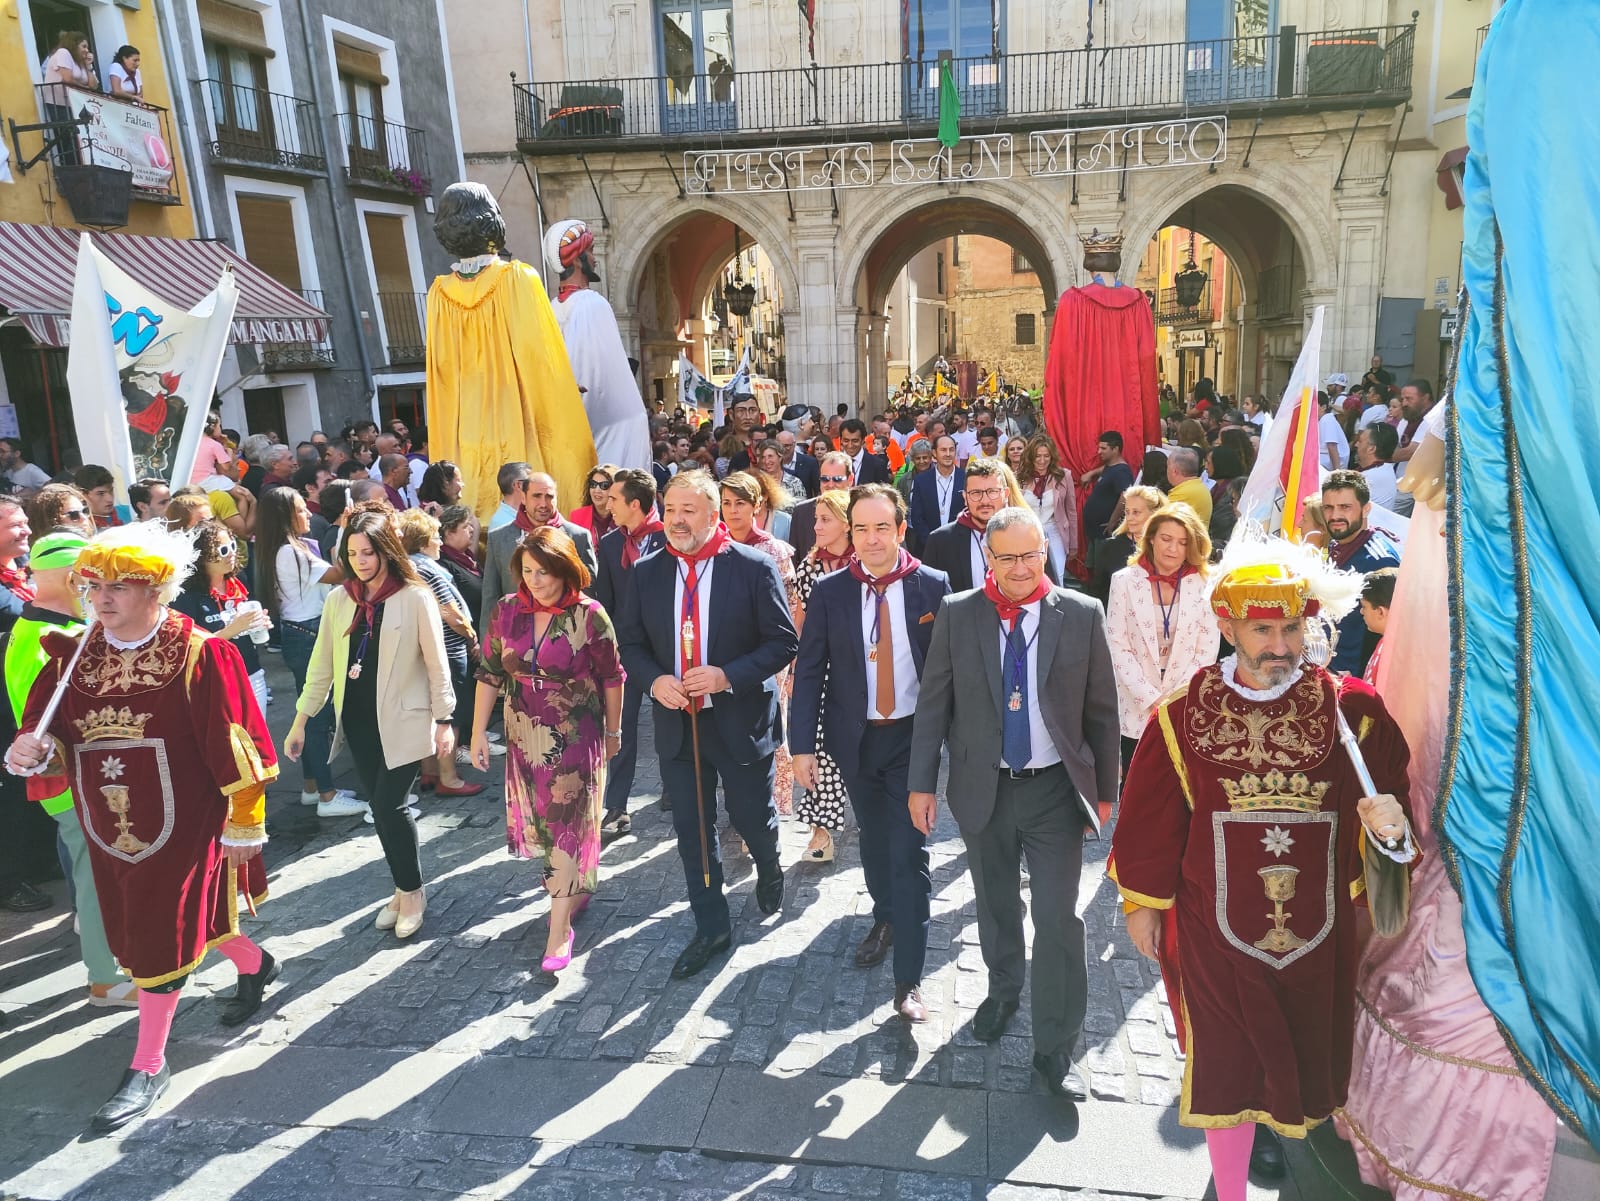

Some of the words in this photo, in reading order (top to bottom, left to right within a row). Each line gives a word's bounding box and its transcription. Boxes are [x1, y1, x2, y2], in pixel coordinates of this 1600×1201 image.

[688, 147, 871, 192] FIESTAS
[894, 137, 1010, 182] SAN
[1032, 121, 1224, 174] MATEO
[231, 320, 317, 343] MANGANA
